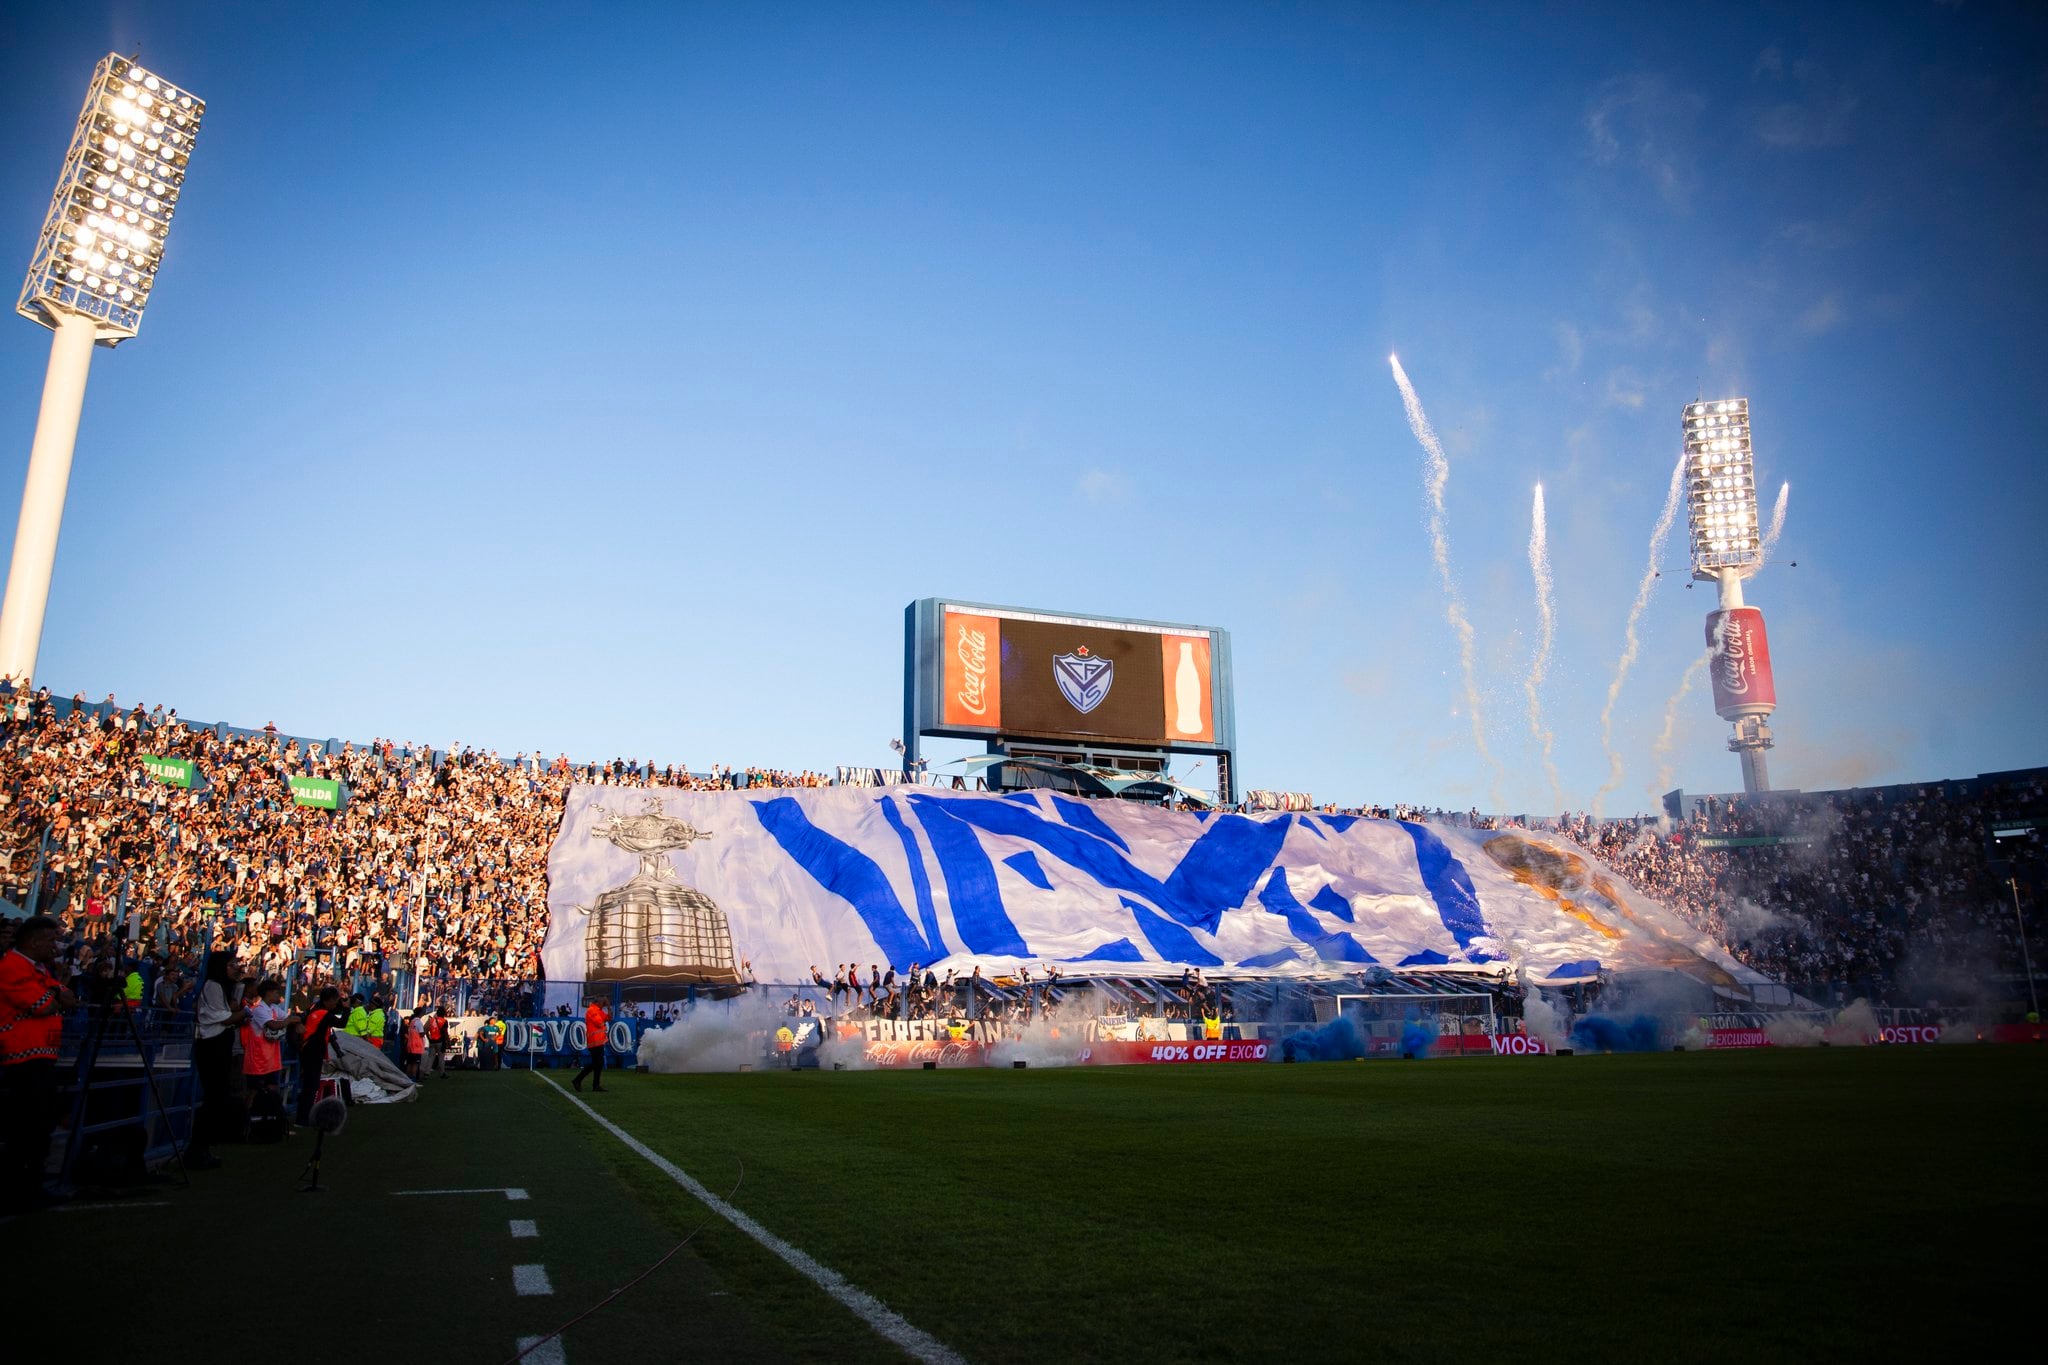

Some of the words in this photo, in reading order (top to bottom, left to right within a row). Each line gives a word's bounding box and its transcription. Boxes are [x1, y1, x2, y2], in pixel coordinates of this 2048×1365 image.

[504, 1020, 633, 1053] DEVOO
[1716, 1032, 1762, 1046] EXCLUSIVO
[1152, 1045, 1189, 1060] 40%
[1193, 1045, 1227, 1060] OFF
